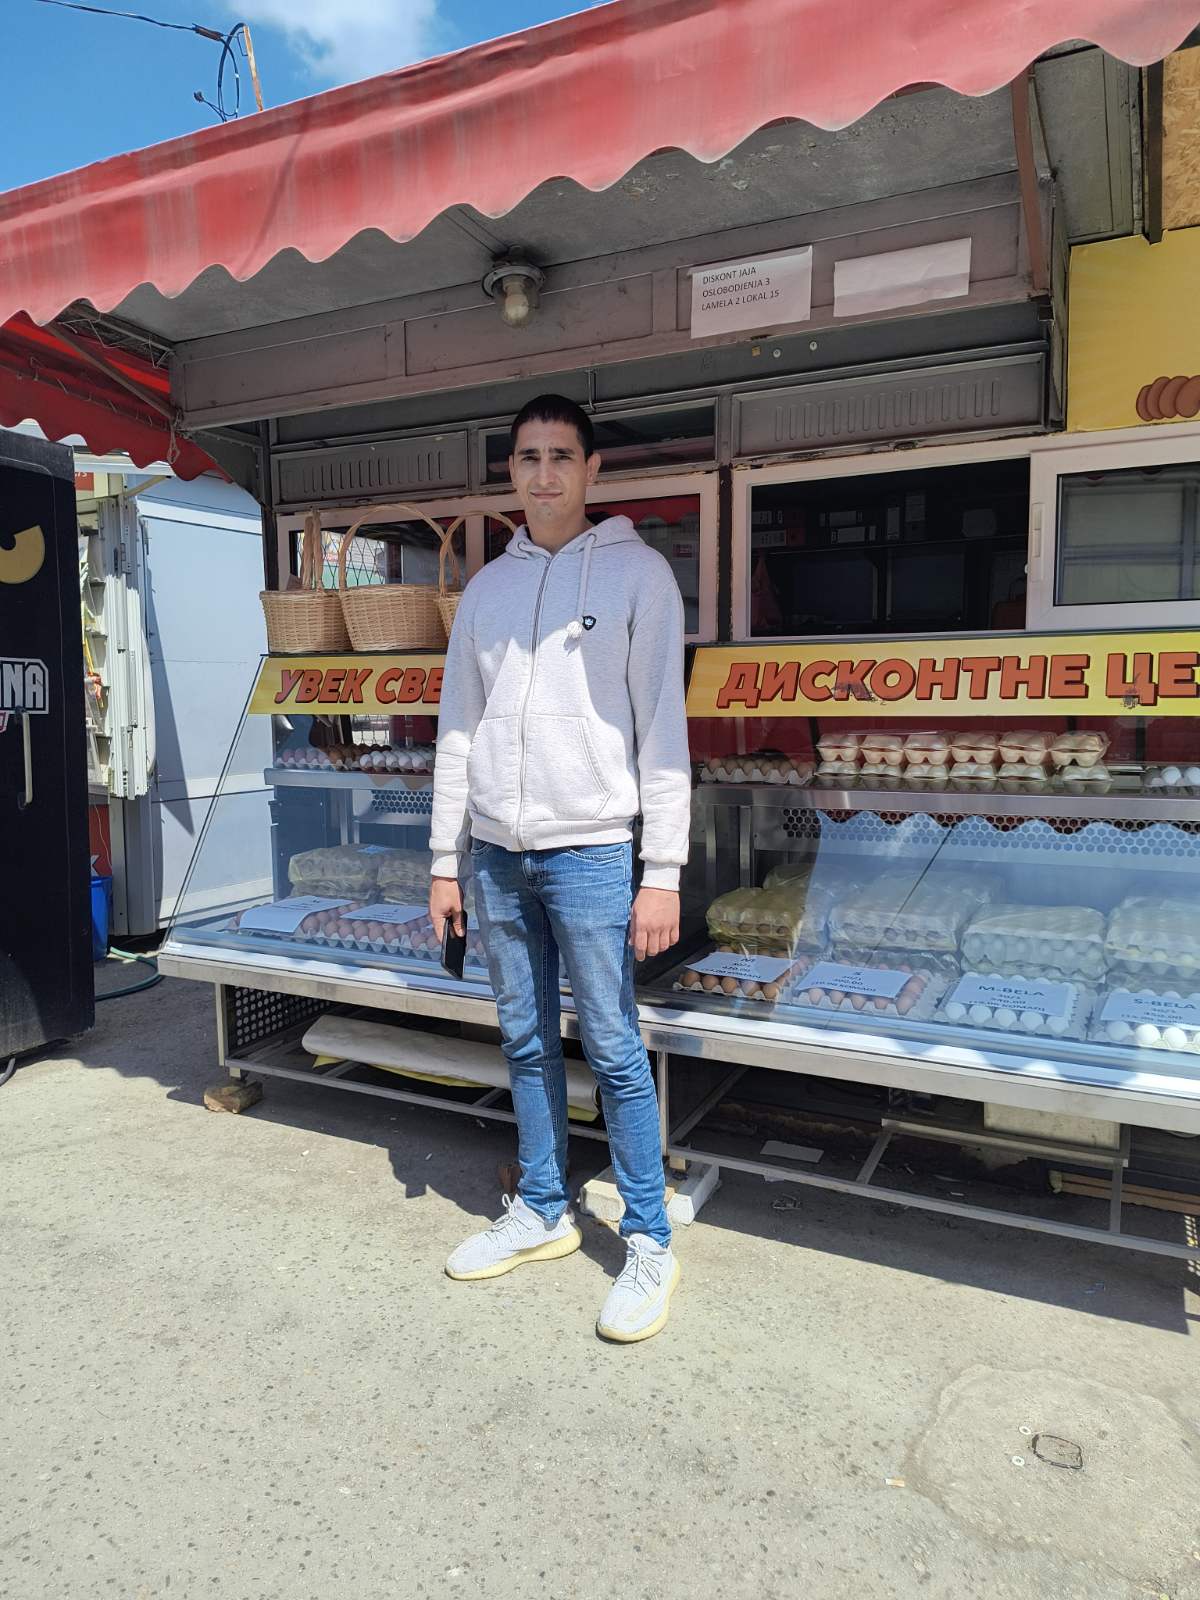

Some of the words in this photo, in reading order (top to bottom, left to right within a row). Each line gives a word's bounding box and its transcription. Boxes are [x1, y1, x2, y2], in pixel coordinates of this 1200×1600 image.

[703, 270, 737, 285] DISKONT
[739, 266, 756, 278] JAJA
[765, 277, 770, 286] 3
[701, 298, 733, 311] LAMELA
[735, 297, 740, 305] 2
[742, 291, 768, 304] LOKAL
[770, 289, 780, 298] 15
[274, 668, 374, 704] УВЕК
[716, 654, 1091, 708] ДИСКОНТНЕ
[1105, 651, 1200, 706] ЦЕ
[979, 985, 1045, 996] M-BELA
[1133, 998, 1197, 1010] S-BELA
